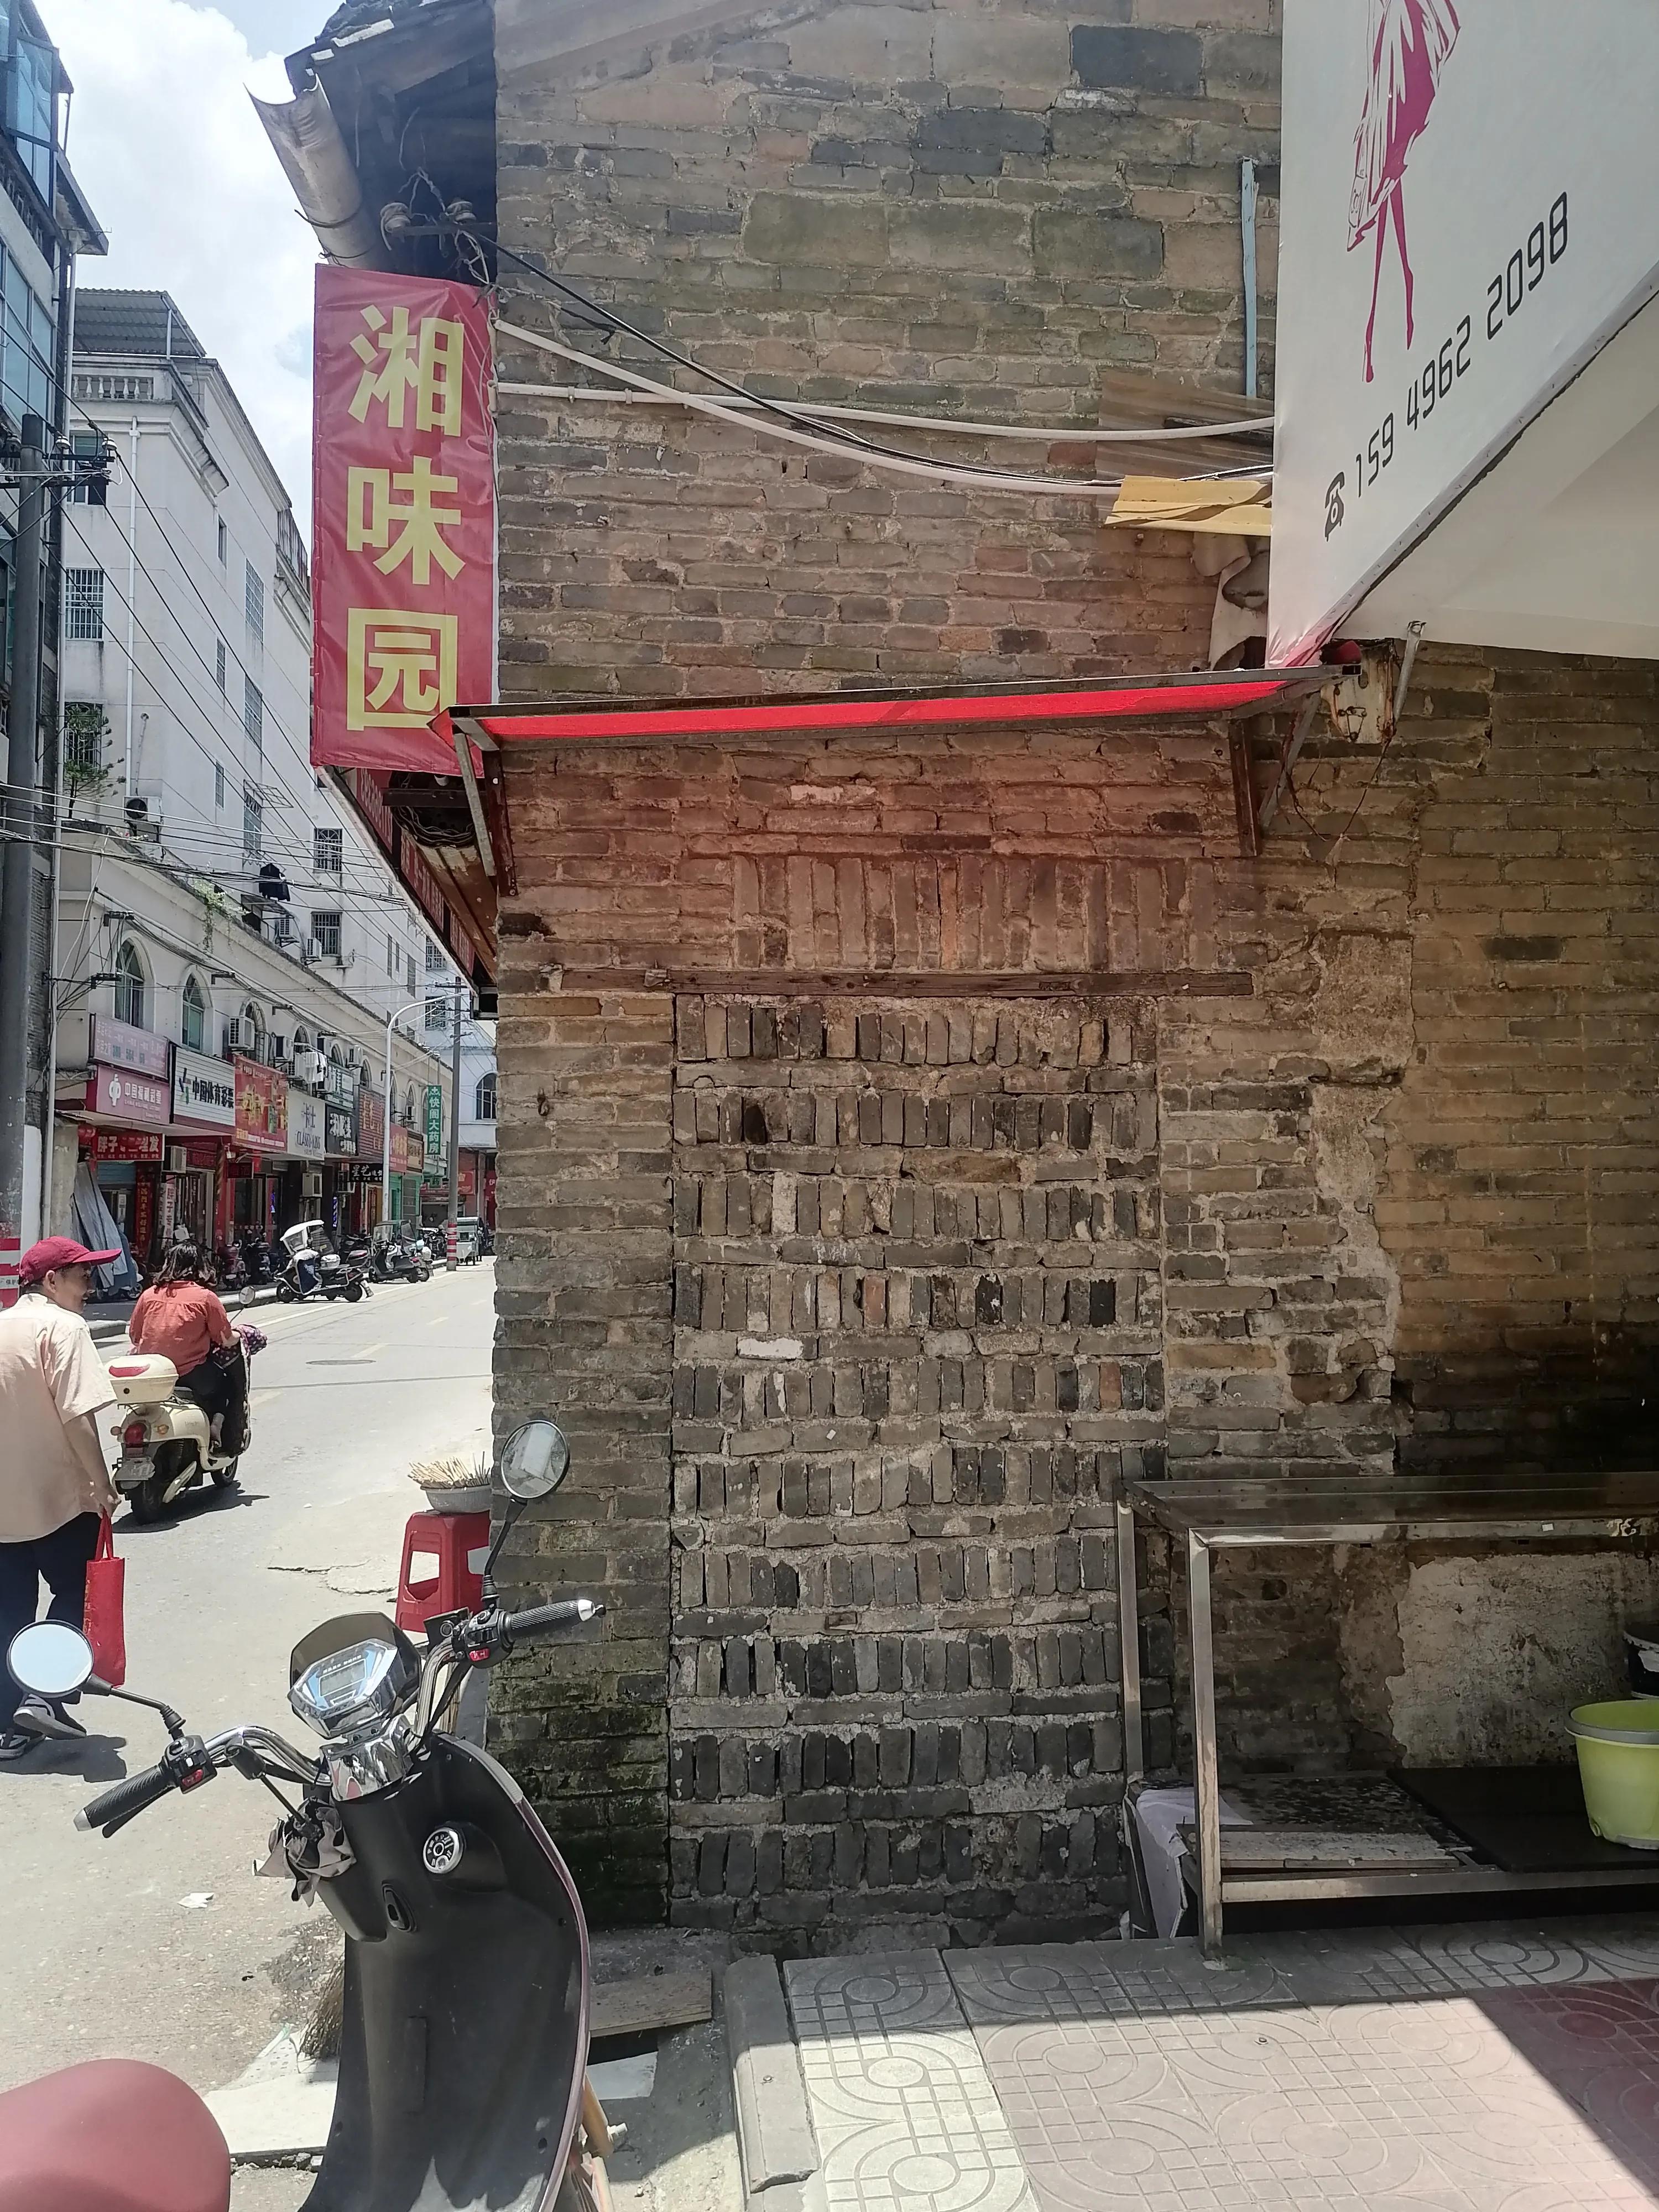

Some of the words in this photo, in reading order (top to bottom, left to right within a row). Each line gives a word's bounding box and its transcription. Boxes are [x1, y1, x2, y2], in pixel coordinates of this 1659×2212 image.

[1356, 412, 1394, 498] 159
[1407, 315, 1471, 431] 4962
[1487, 191, 1567, 340] 2098
[347, 304, 466, 732] 湘味园
[192, 1076, 233, 1109] 中国体育彩票
